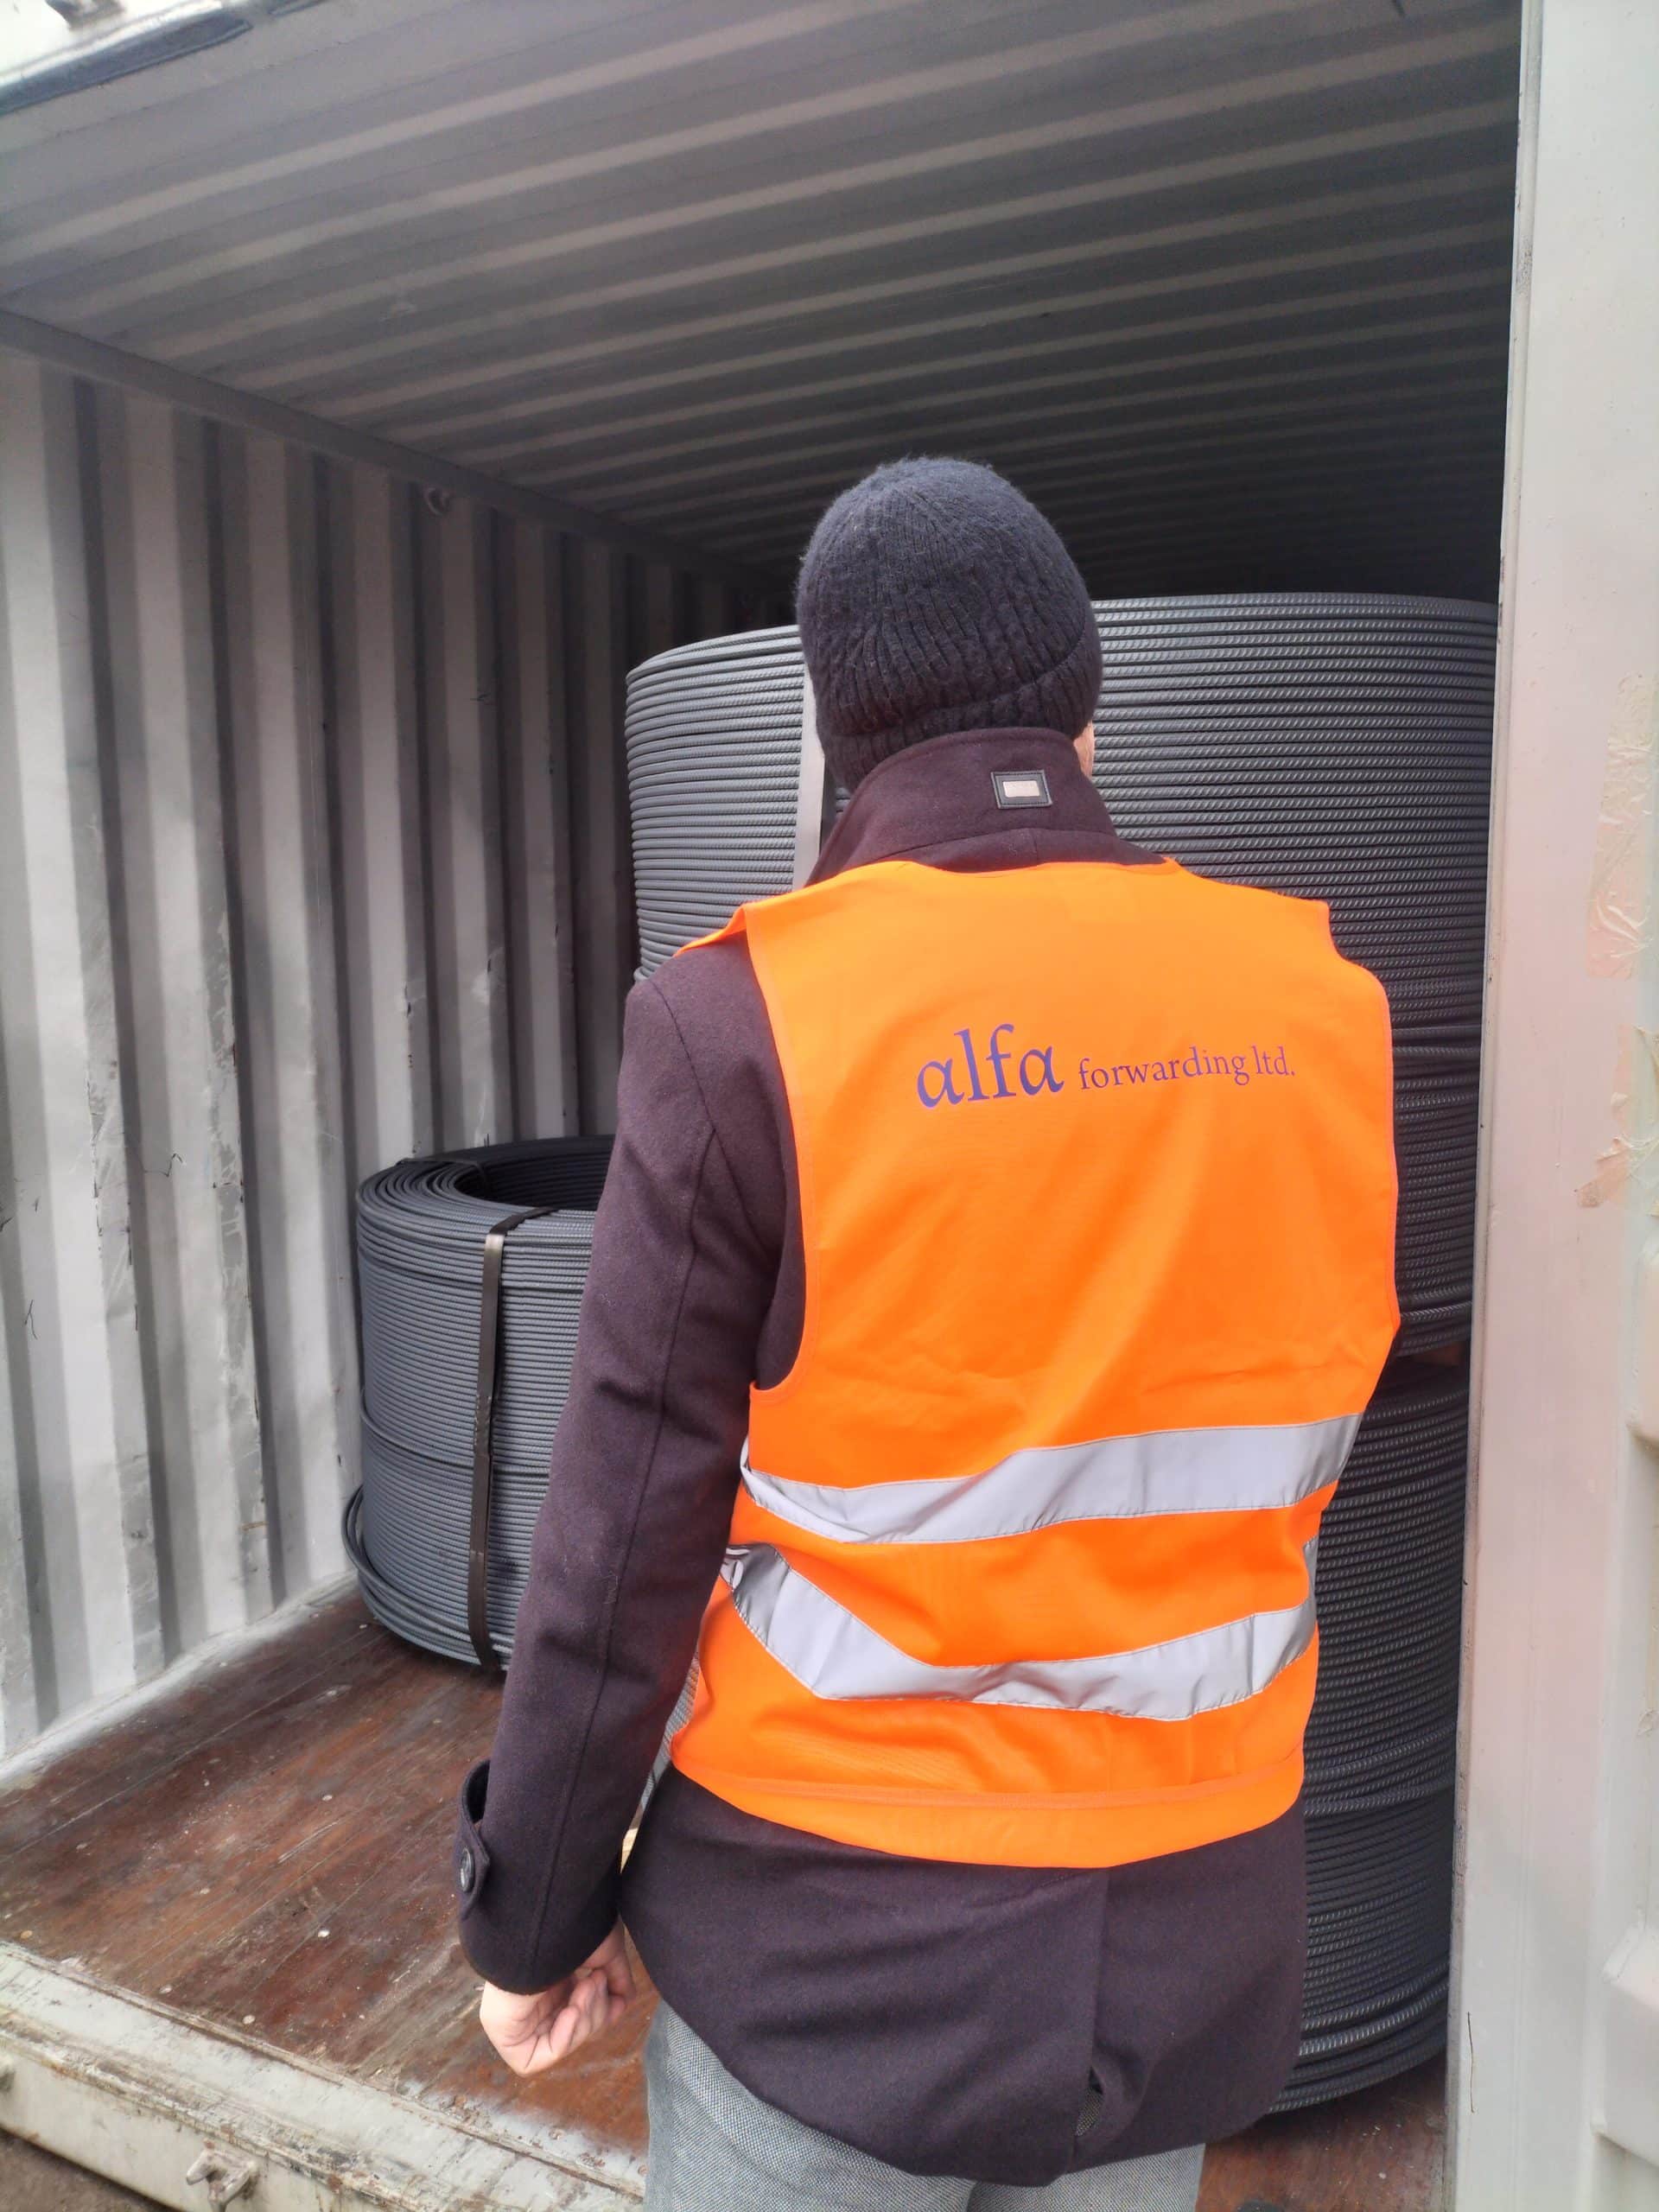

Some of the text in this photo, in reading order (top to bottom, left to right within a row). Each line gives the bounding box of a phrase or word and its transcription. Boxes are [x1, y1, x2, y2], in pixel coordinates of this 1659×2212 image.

[917, 1023, 1296, 1109] alfa forwarding ltd.
